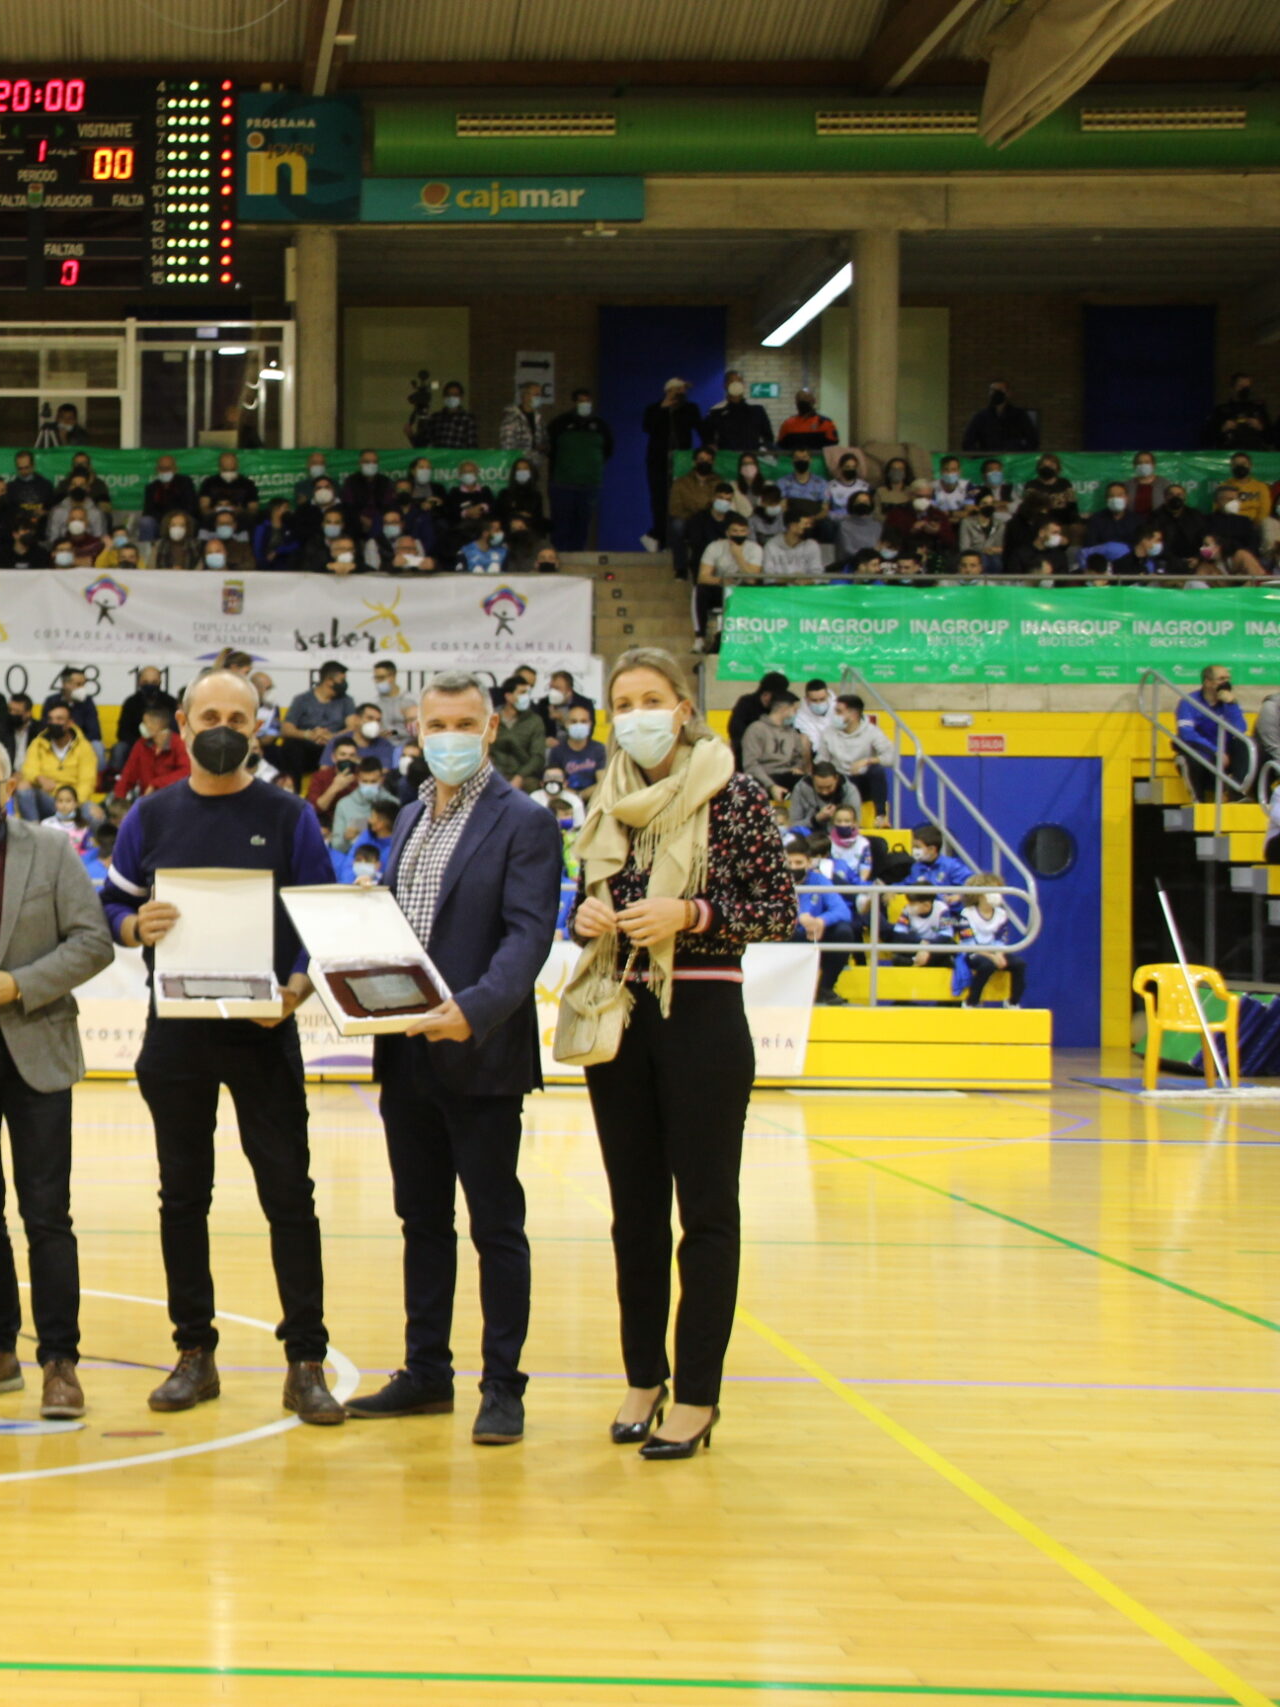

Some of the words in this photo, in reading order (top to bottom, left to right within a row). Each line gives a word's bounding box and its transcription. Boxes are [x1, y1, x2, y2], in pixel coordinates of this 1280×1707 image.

[77, 122, 134, 138] VISITANTE
[246, 118, 317, 129] PROGRAMA
[36, 139, 49, 163] 1
[92, 147, 134, 181] 00
[42, 194, 93, 208] JUGADOR
[112, 194, 145, 207] FALTA
[455, 182, 586, 215] cajamar
[43, 243, 86, 257] FALTAS
[800, 618, 899, 634] INAGROUP
[909, 619, 1010, 635] INAGROUP
[1020, 620, 1122, 636] INAGROUP
[1132, 620, 1234, 636] INAGROUP
[294, 617, 413, 653] sabores
